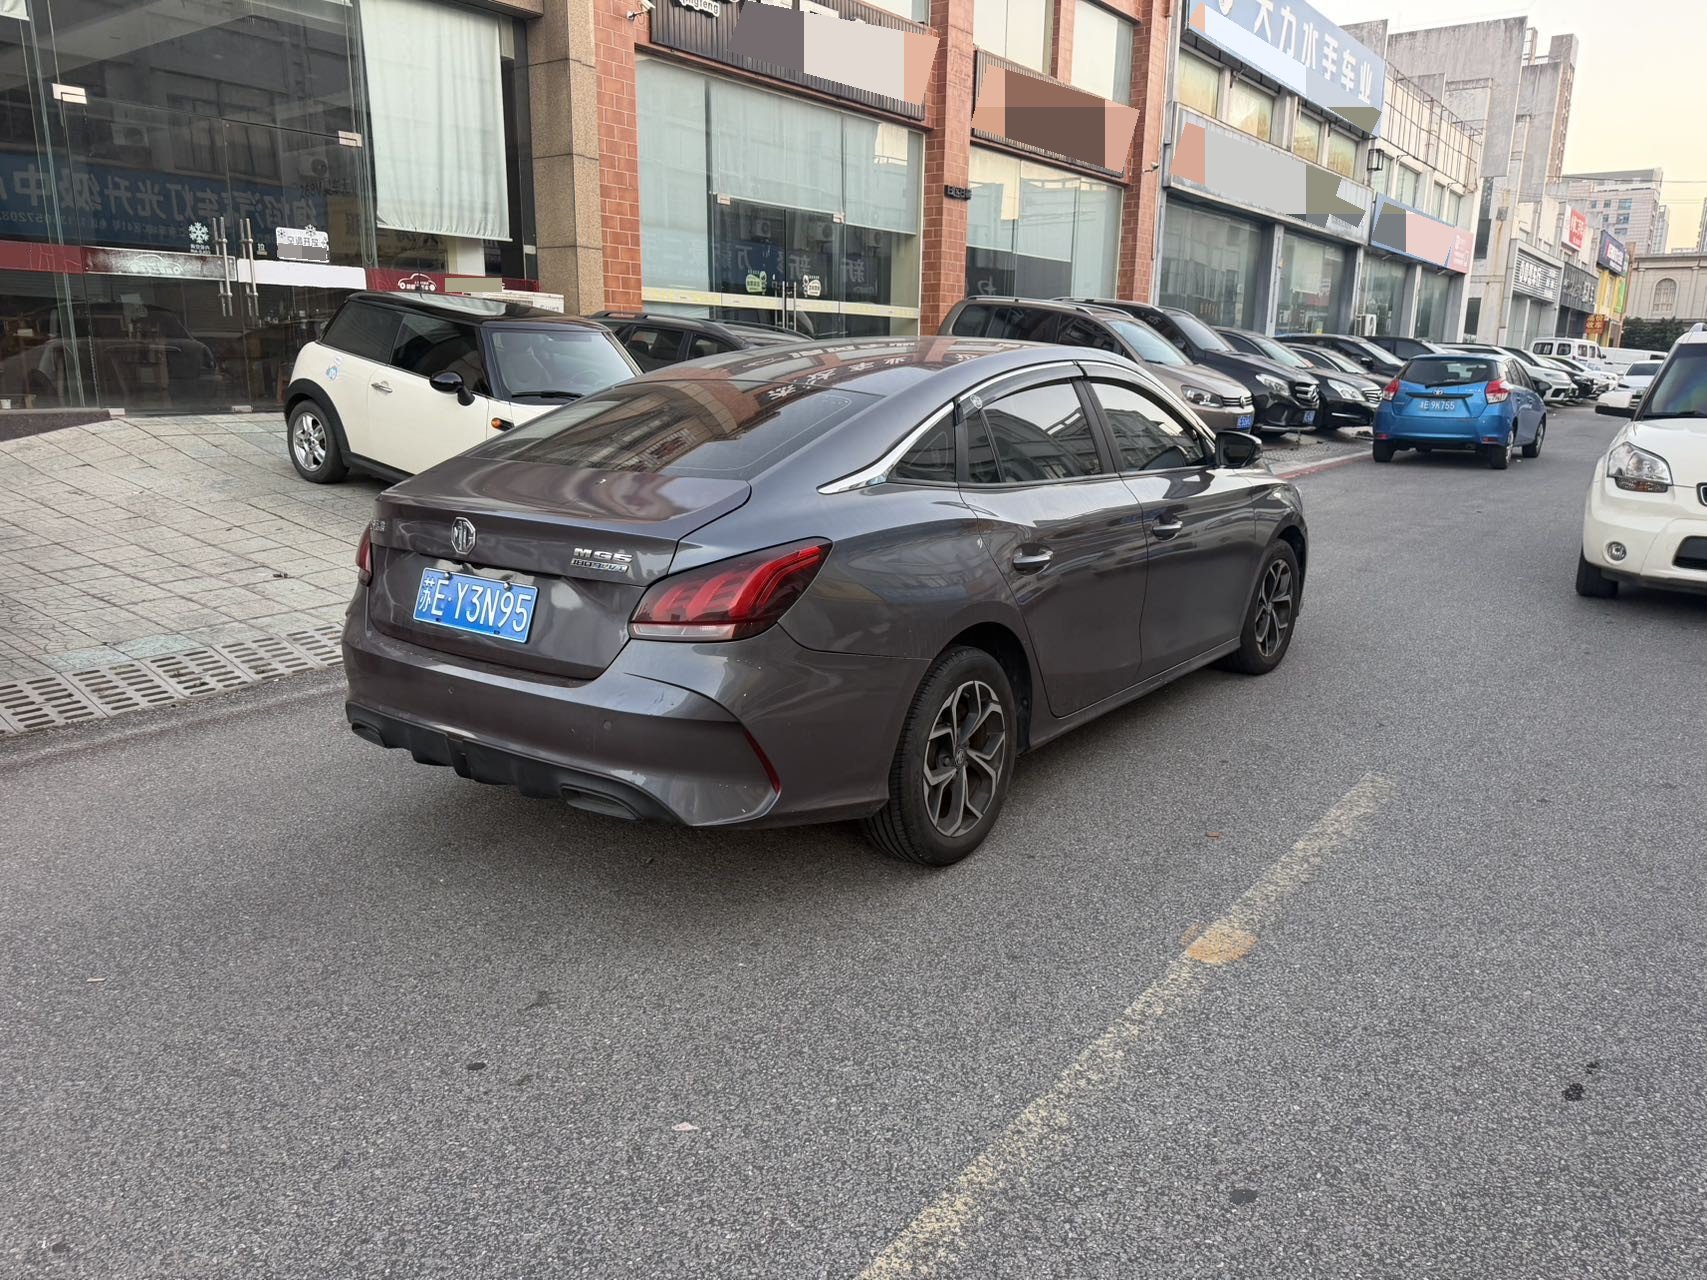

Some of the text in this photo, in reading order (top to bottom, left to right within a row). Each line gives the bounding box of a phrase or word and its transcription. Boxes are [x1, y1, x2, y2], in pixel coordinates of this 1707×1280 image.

[1253, 0, 1374, 104] 大力水手车业
[573, 547, 633, 563] MG5
